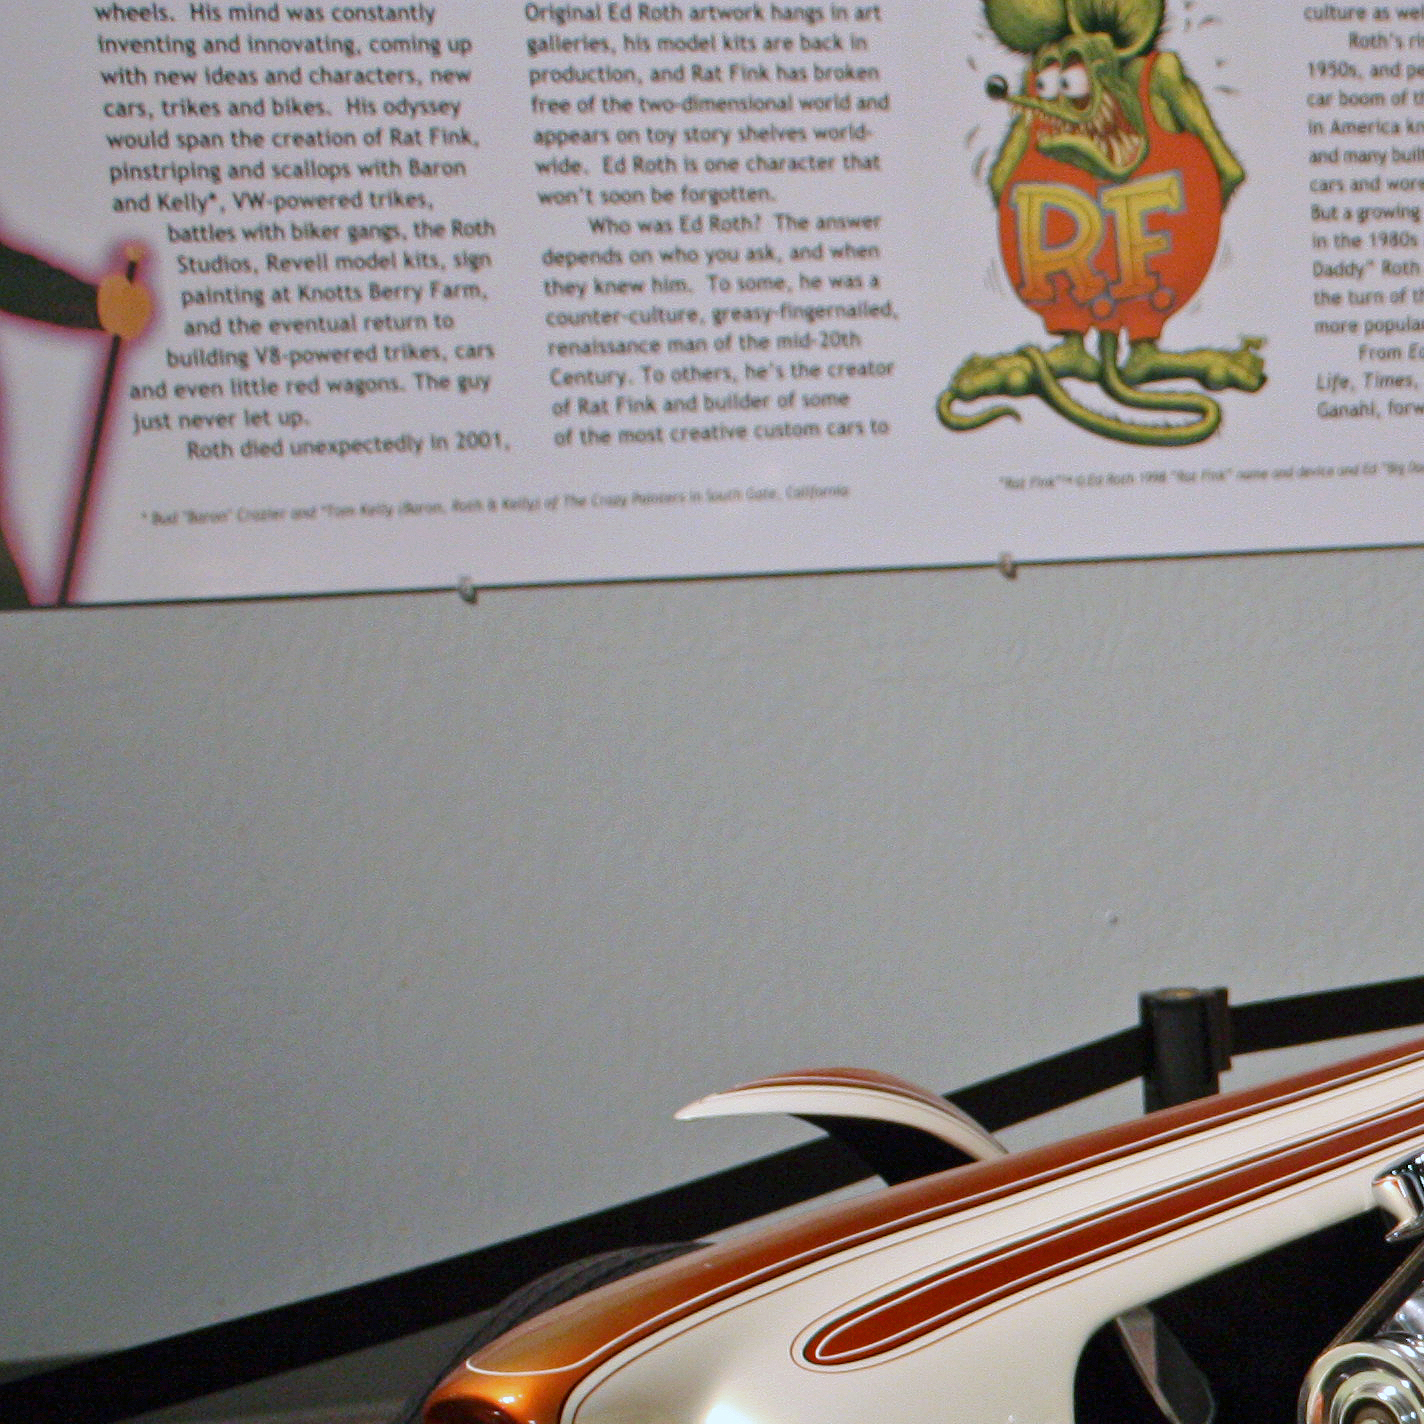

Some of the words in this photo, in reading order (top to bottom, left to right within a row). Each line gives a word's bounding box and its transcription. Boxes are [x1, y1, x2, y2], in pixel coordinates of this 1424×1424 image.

[93, 2, 176, 22] wheels.
[189, 2, 223, 22] His
[228, 2, 280, 22] mind
[285, 7, 326, 22] was
[330, 3, 437, 26] constantly
[524, 2, 601, 27] Original
[608, 3, 632, 23] Ed
[638, 3, 683, 22] Roth
[689, 3, 764, 22] artwork
[770, 3, 825, 27] hangs
[830, 4, 848, 21] in
[855, 5, 881, 22] art
[1304, 4, 1367, 21] culture
[1372, 7, 1391, 22] as
[97, 35, 197, 59] inventing
[202, 34, 241, 54] and
[247, 35, 362, 59] innovating,
[368, 35, 442, 58] coming
[447, 38, 473, 57] up
[526, 34, 616, 58] galleries,
[623, 33, 651, 53] his
[657, 34, 716, 53] model
[722, 34, 757, 52] kits
[763, 37, 794, 53] are
[799, 34, 844, 53] back
[850, 34, 868, 50] in
[100, 66, 147, 85] with
[154, 70, 198, 85] new
[204, 65, 258, 86] ideas
[264, 66, 302, 86] and
[308, 66, 422, 86] characters,
[430, 69, 472, 84] new
[528, 64, 643, 88] production,
[649, 64, 686, 83] and
[690, 63, 723, 83] Rat
[728, 63, 771, 82] Fink
[775, 63, 809, 82] has
[813, 63, 881, 82] broken
[1370, 61, 1401, 79] and
[103, 102, 153, 120] cars,
[161, 97, 221, 118] trikes
[228, 98, 265, 117] and
[271, 97, 331, 117] bikes.
[346, 97, 377, 116] His
[383, 96, 461, 120] odyssey
[106, 130, 169, 149] would
[177, 132, 224, 153] span
[230, 128, 264, 148] the
[272, 129, 356, 148] creation
[363, 127, 382, 147] of
[390, 127, 422, 147] Rat
[429, 126, 479, 148] Fink,
[535, 129, 609, 148] appears
[617, 129, 639, 144] on
[647, 127, 675, 147] toy
[684, 127, 729, 146] story
[739, 124, 806, 143] shelves
[109, 161, 222, 185] pinstriping
[227, 159, 265, 180] and
[271, 159, 352, 183] scallops
[357, 158, 402, 177] with
[408, 157, 467, 178] Baron
[535, 156, 588, 175] wide.
[602, 155, 627, 175] Ed
[632, 155, 677, 175] Roth
[683, 156, 699, 173] is
[704, 158, 740, 173] one
[745, 154, 835, 173] character
[842, 153, 881, 172] that
[539, 187, 592, 206] won't
[601, 189, 644, 205] soon
[651, 186, 674, 204] be
[682, 184, 776, 208] forgotten.
[1309, 179, 1346, 194] cars
[1350, 175, 1382, 192] and
[112, 193, 151, 213] and
[232, 190, 363, 214] VW-powered
[369, 189, 433, 211] trikes,
[176, 254, 259, 275] Studios,
[265, 252, 329, 272] Revell
[334, 252, 397, 271] model
[402, 251, 447, 271] kits,
[452, 250, 493, 273] sign
[181, 286, 266, 309] painting
[271, 285, 291, 304] at
[297, 284, 363, 303] Knotts
[368, 282, 423, 304] Berry
[429, 280, 488, 301] Farm,
[1314, 320, 1360, 335] more
[166, 347, 250, 371] building
[254, 343, 378, 369] V8-powered
[383, 343, 448, 362] trikes,
[454, 344, 496, 360] cars
[547, 339, 662, 357] renaissance
[667, 338, 709, 353] man
[713, 333, 733, 353] of
[738, 334, 772, 351] the
[1359, 344, 1402, 361] From
[550, 368, 633, 388] Century.
[642, 364, 665, 384] To
[671, 365, 736, 384] others,
[745, 362, 784, 381] he's
[791, 362, 821, 379] the
[828, 361, 894, 378] creator
[188, 440, 233, 460] Roth
[241, 439, 283, 459] died
[291, 434, 422, 458] unexpectedly
[431, 434, 448, 450] in
